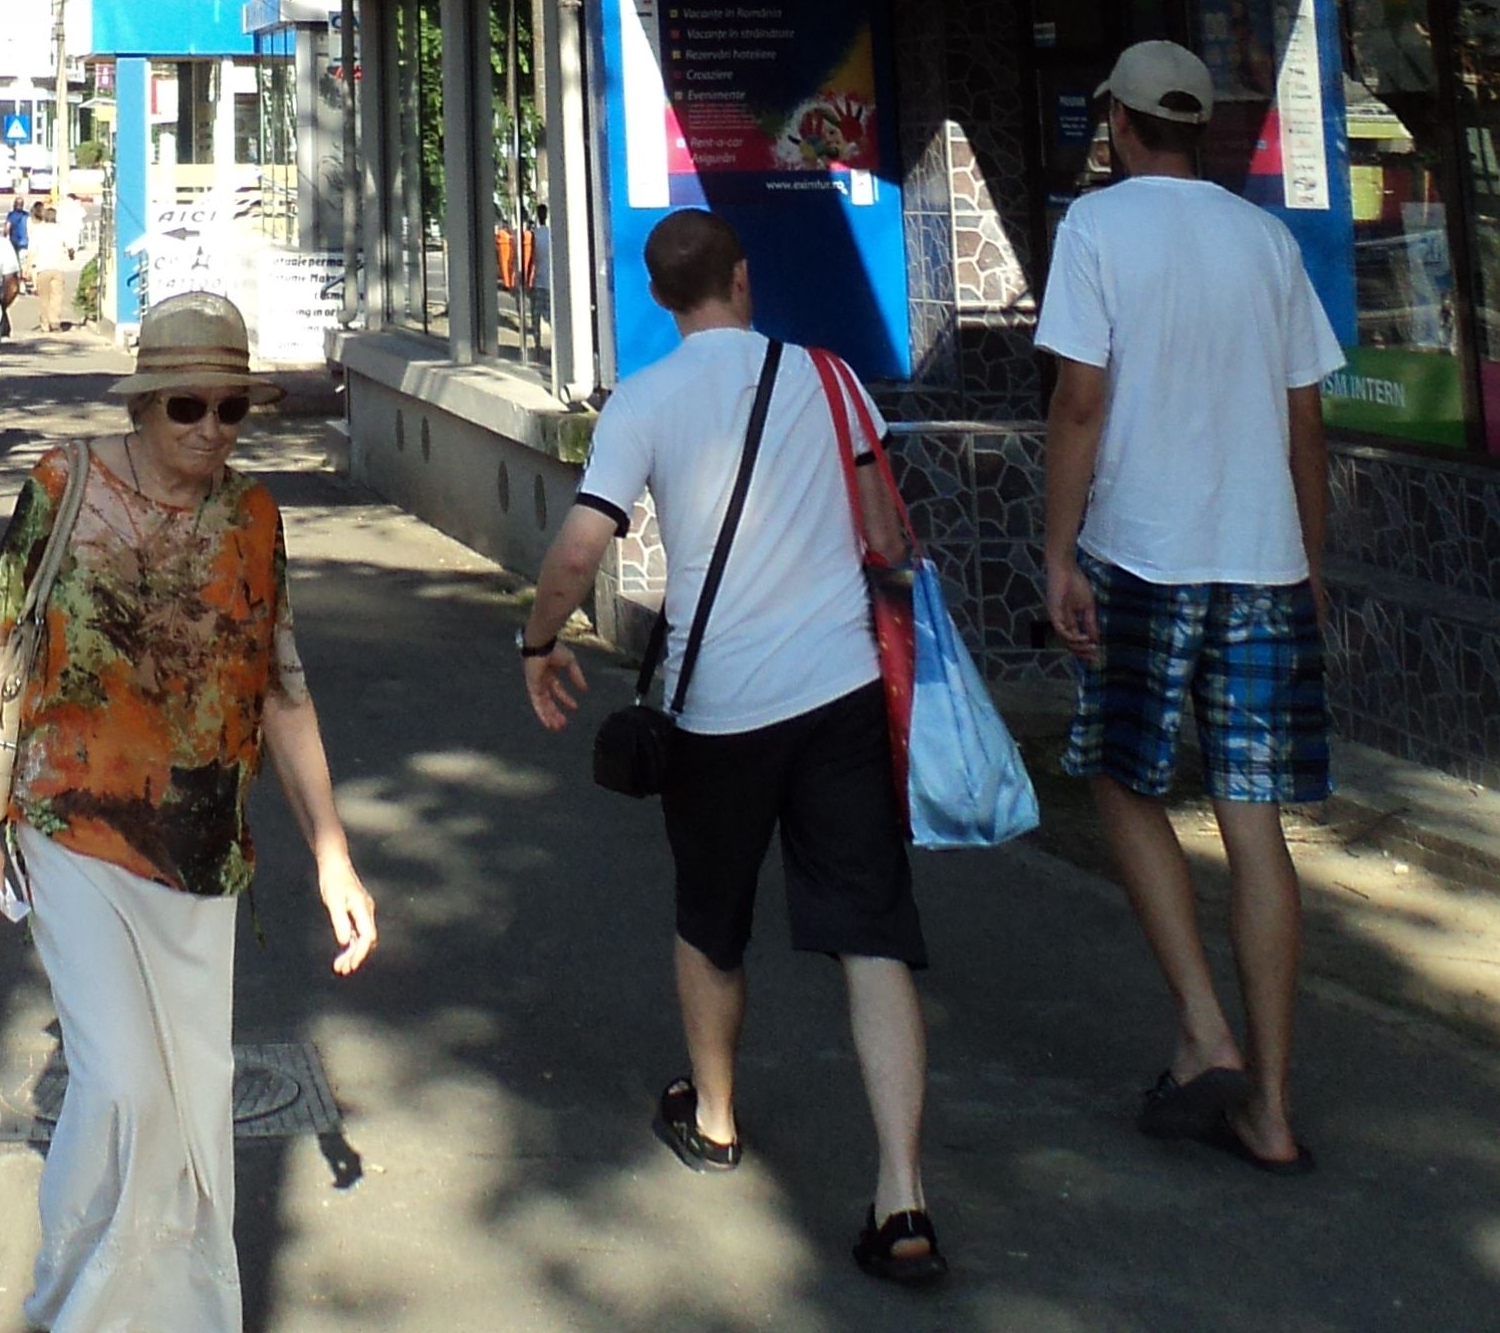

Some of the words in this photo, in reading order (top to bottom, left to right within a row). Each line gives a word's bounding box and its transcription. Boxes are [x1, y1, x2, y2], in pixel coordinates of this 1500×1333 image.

[686, 69, 734, 80] Croaziere
[687, 90, 746, 101] Evenimente
[690, 137, 744, 148] Rent-a-car
[158, 210, 217, 223] AICI
[1350, 374, 1406, 408] INTERN
